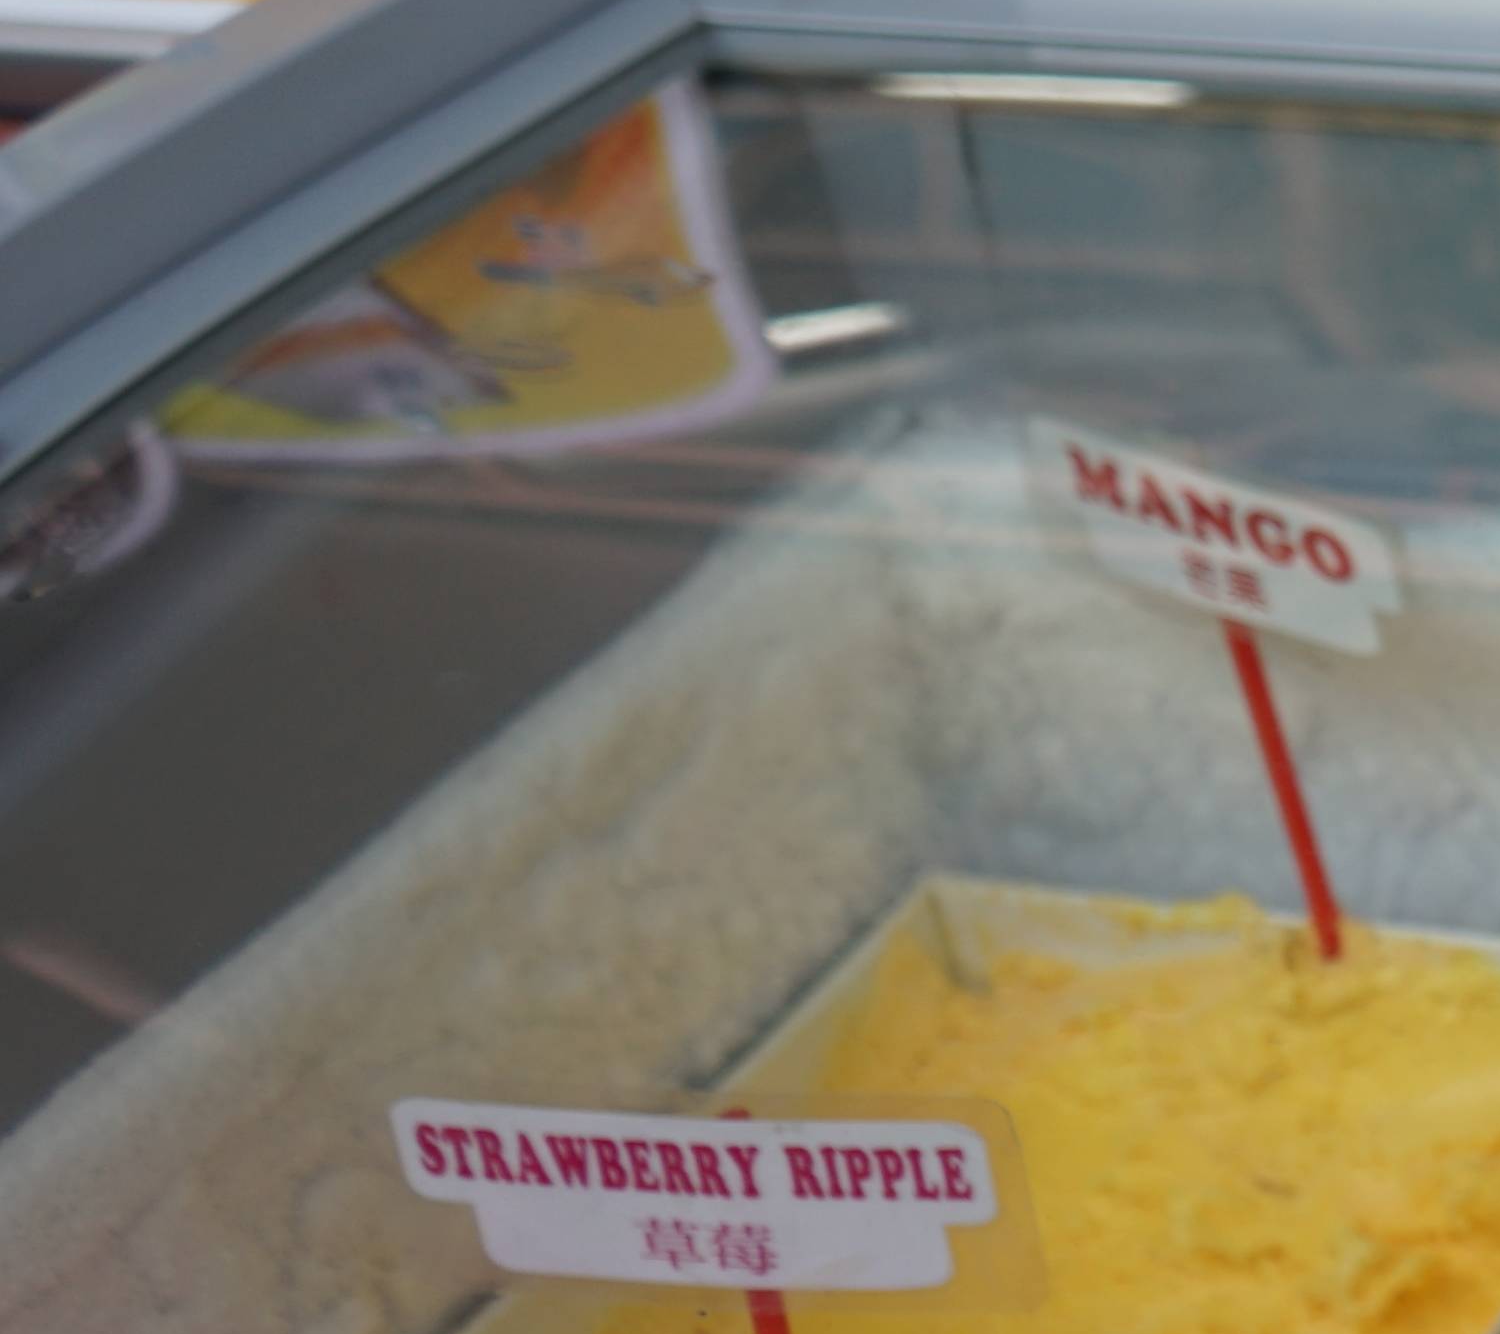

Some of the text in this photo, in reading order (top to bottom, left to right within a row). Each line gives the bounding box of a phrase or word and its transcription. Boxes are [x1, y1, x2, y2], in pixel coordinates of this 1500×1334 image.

[1062, 439, 1357, 584] MANGO
[414, 1123, 974, 1203] STRAWBERRY RIPPLE
[640, 1217, 778, 1276] 草莓
